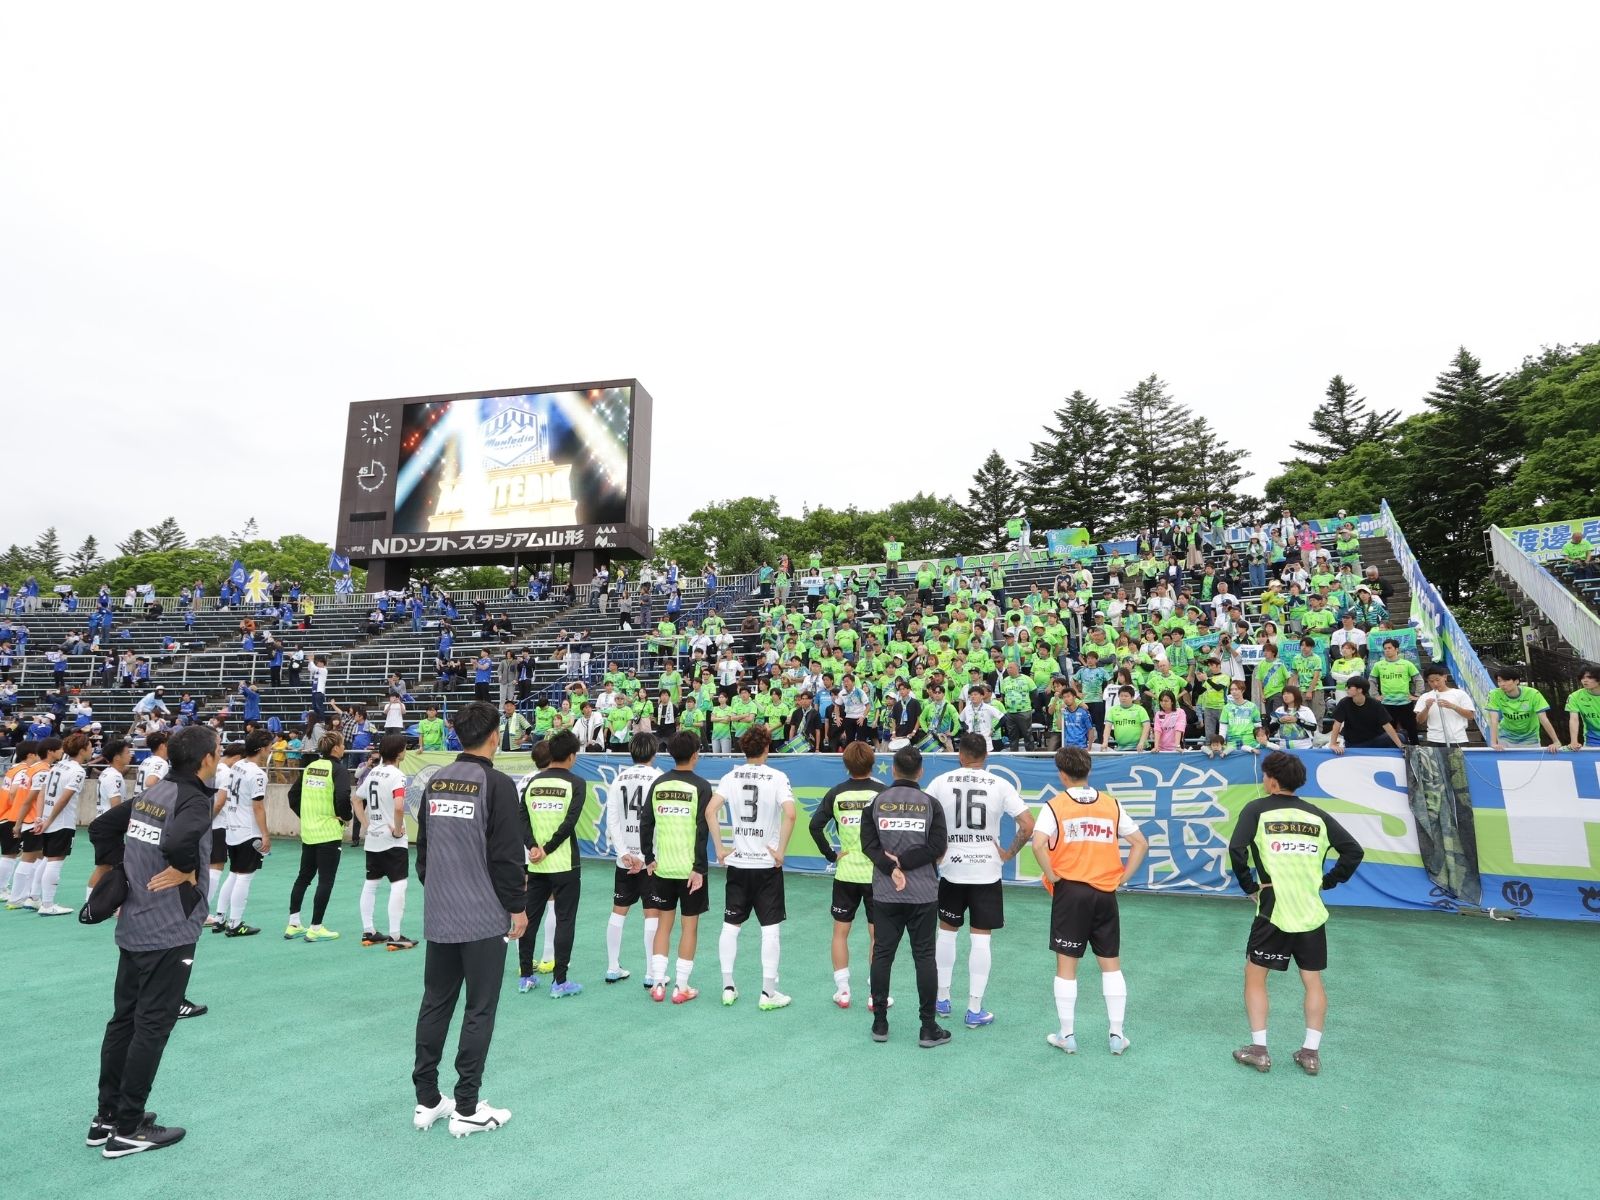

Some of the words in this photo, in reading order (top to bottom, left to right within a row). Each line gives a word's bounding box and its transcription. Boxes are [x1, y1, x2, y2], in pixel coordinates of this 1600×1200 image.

[371, 529, 585, 555] NDソフトスタジアム山形
[946, 774, 996, 785] 産業能率大学
[448, 782, 478, 793] RIZAP
[368, 780, 379, 810] 6
[620, 785, 645, 821] 14
[740, 784, 758, 823] 3
[899, 804, 926, 812] RIZAP
[952, 788, 987, 830] 16
[1290, 824, 1319, 834] RIZAP
[1061, 940, 1082, 948] コクエー
[1264, 953, 1290, 961] コクエー
